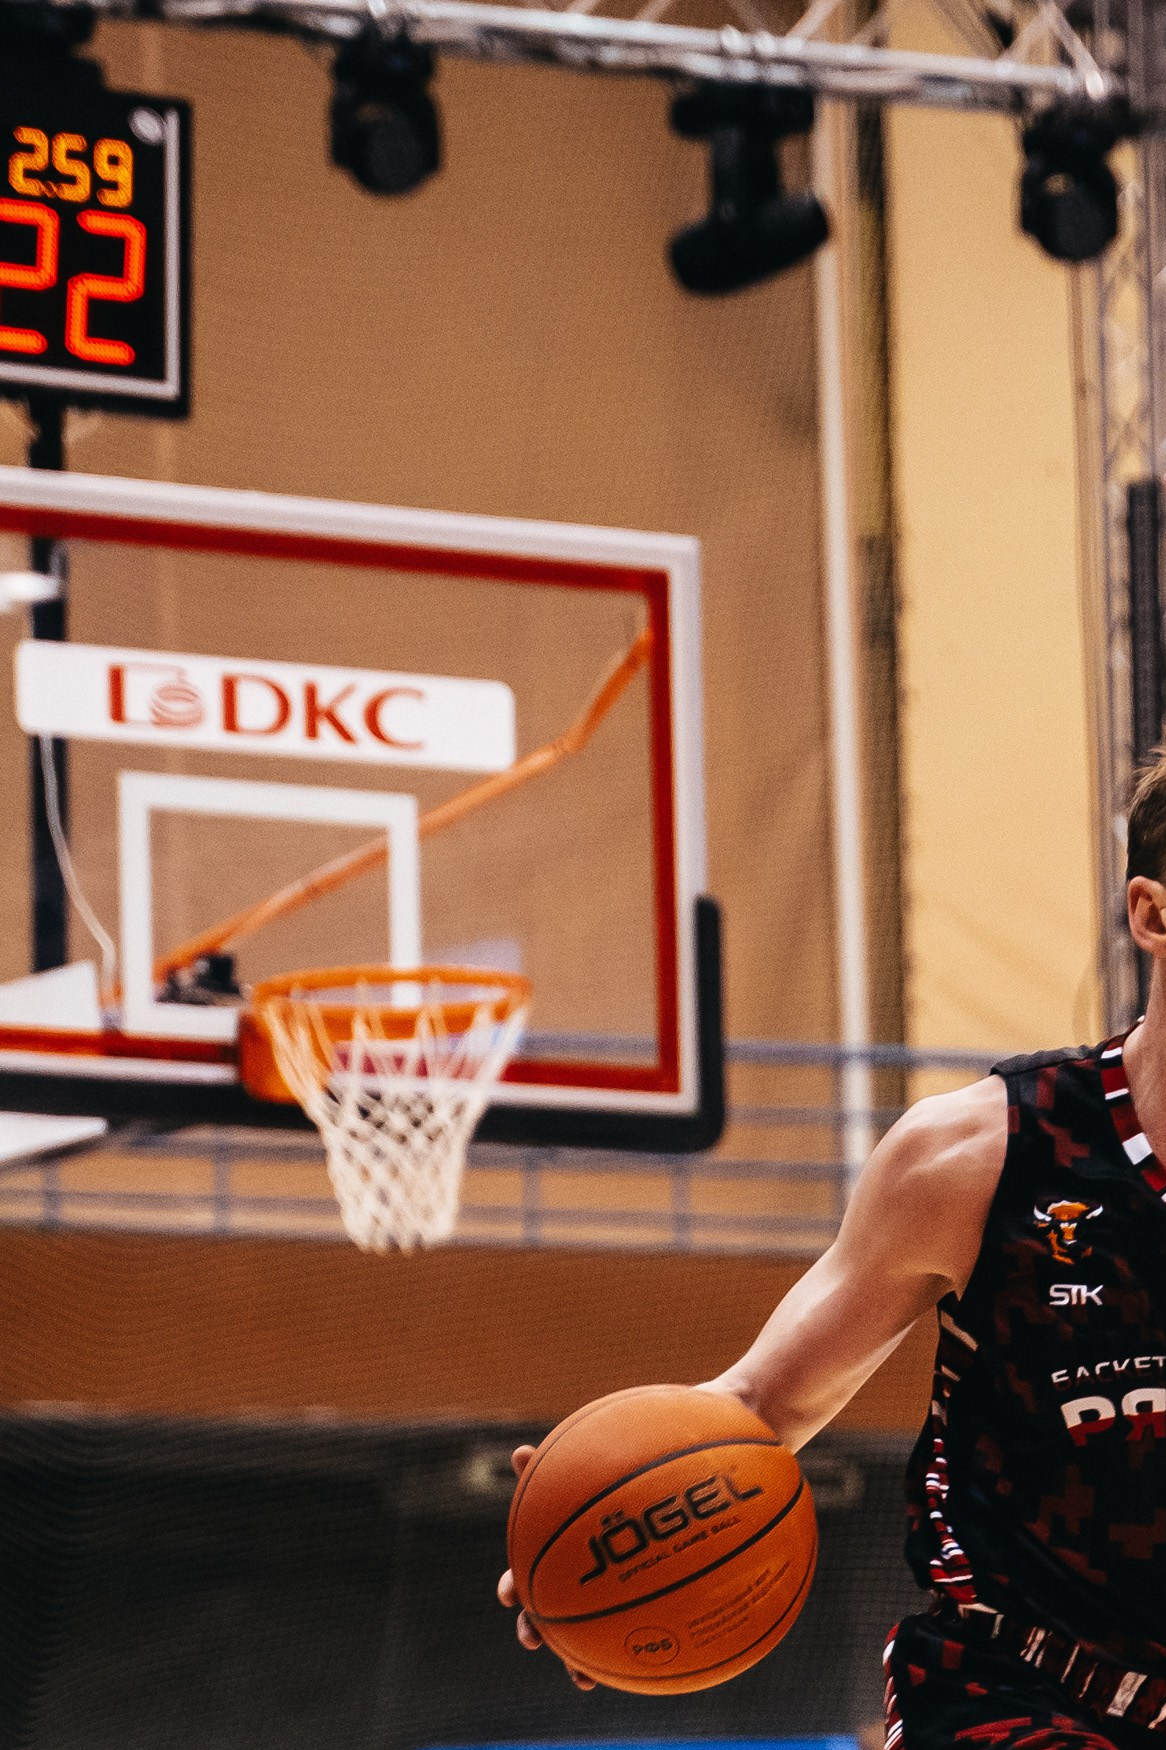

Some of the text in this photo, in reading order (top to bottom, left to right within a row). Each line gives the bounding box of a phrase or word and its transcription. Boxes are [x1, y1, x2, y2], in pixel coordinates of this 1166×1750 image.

[219, 671, 426, 752] DKC
[1049, 1284, 1104, 1306] STK
[579, 1473, 764, 1585] JÖGEL
